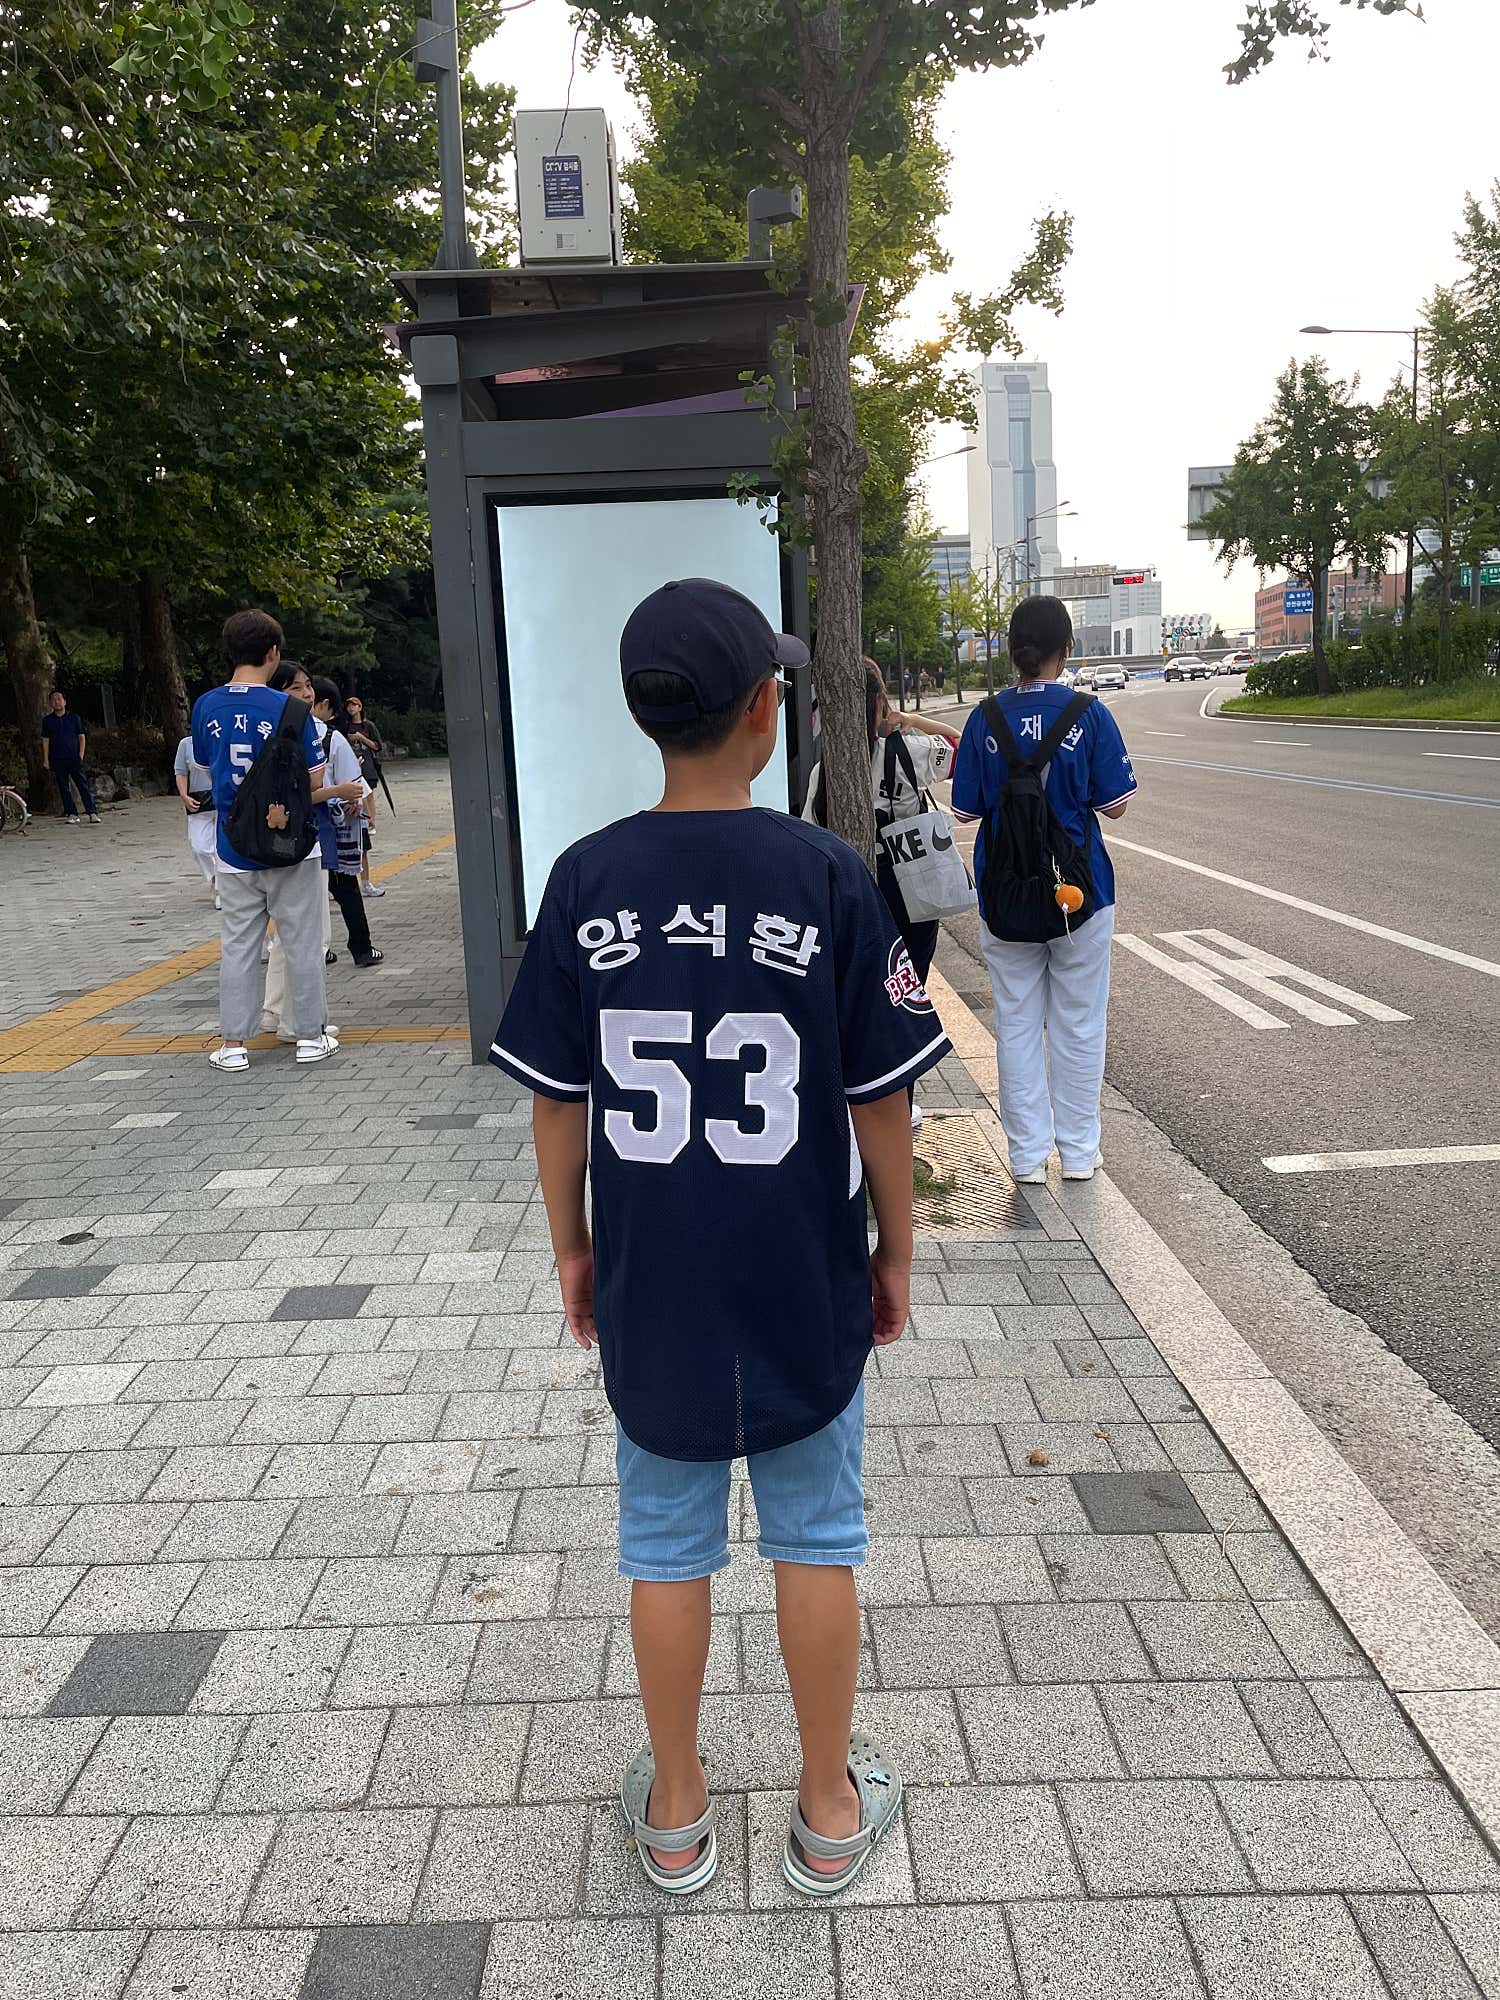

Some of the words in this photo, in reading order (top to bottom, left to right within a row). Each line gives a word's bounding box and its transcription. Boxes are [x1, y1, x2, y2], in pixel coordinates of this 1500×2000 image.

[206, 713, 273, 740] 구자욱
[576, 904, 821, 977] 양석환
[600, 1008, 801, 1165] 53
